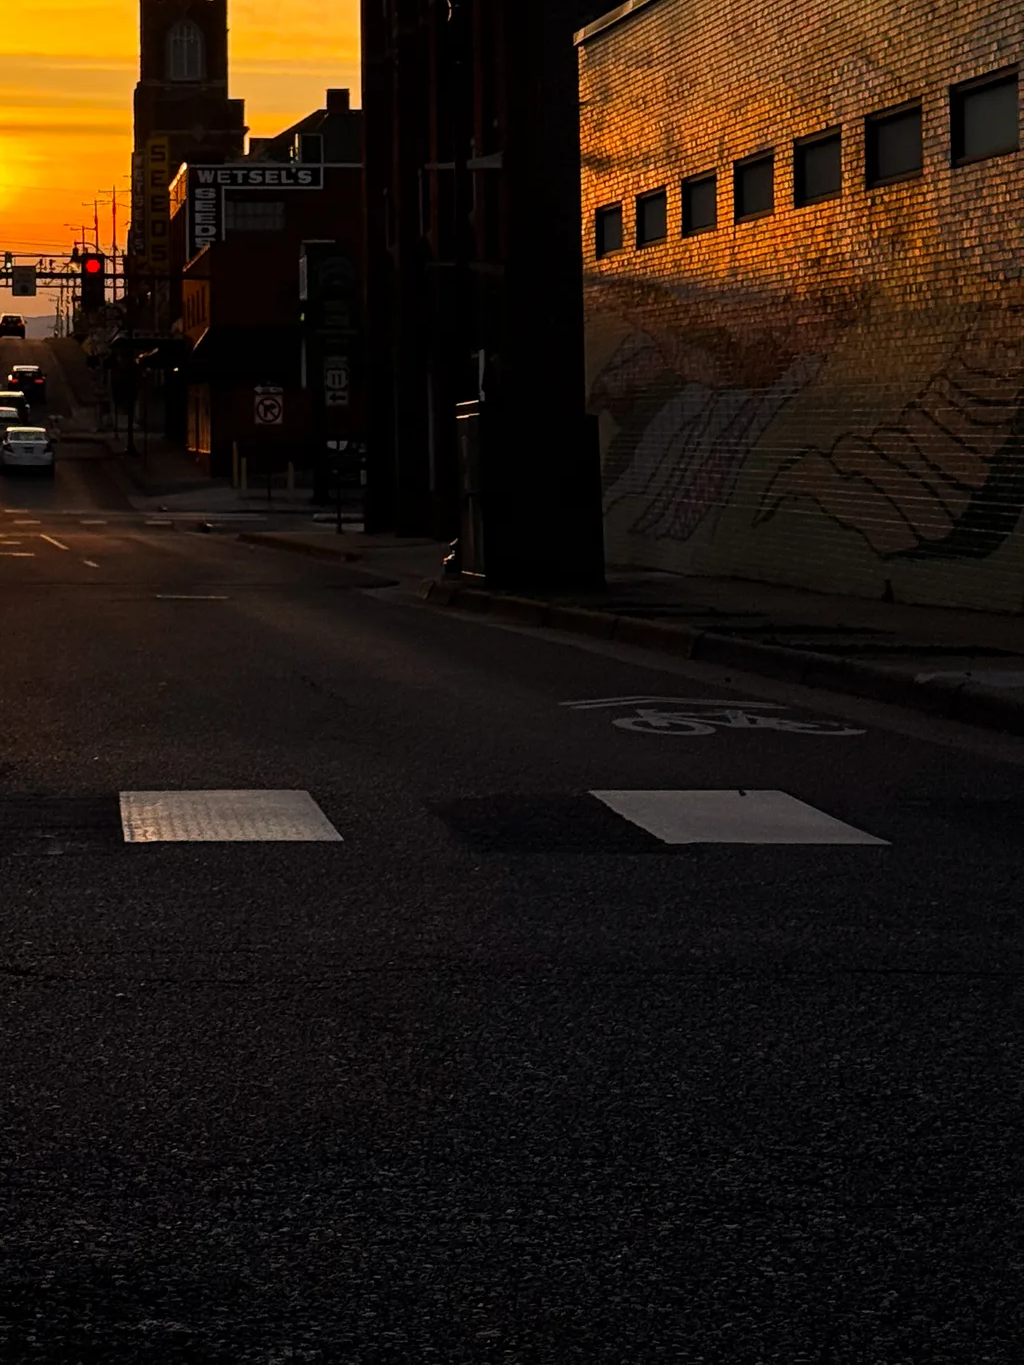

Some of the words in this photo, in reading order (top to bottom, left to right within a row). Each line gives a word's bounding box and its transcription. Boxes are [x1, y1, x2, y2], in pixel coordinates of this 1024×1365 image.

[150, 143, 167, 261] SEEDS
[196, 169, 313, 184] WETSEL'S
[194, 187, 217, 249] SEEDS
